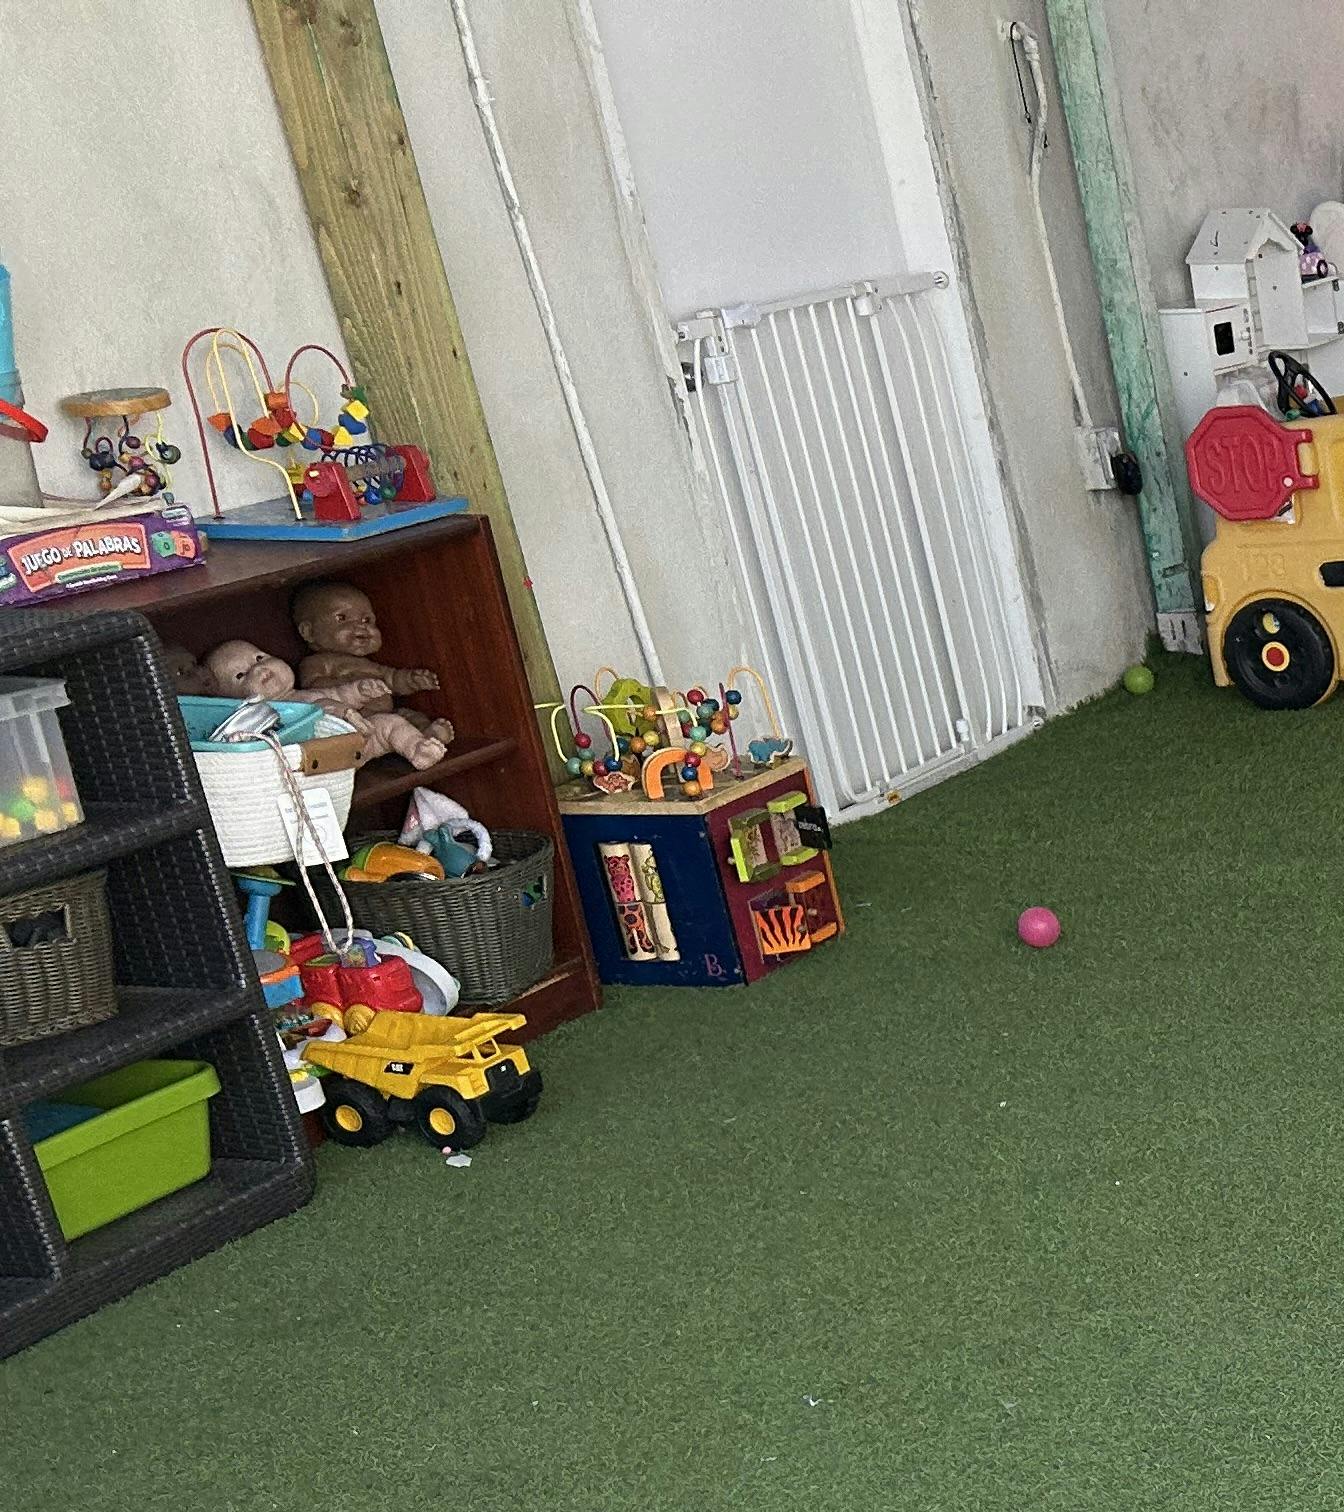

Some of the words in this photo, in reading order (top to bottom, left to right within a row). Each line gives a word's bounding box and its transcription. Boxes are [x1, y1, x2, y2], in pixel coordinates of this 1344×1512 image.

[1204, 432, 1279, 495] STOP
[21, 546, 62, 575] JUEGO
[73, 535, 142, 558] PALABRAS
